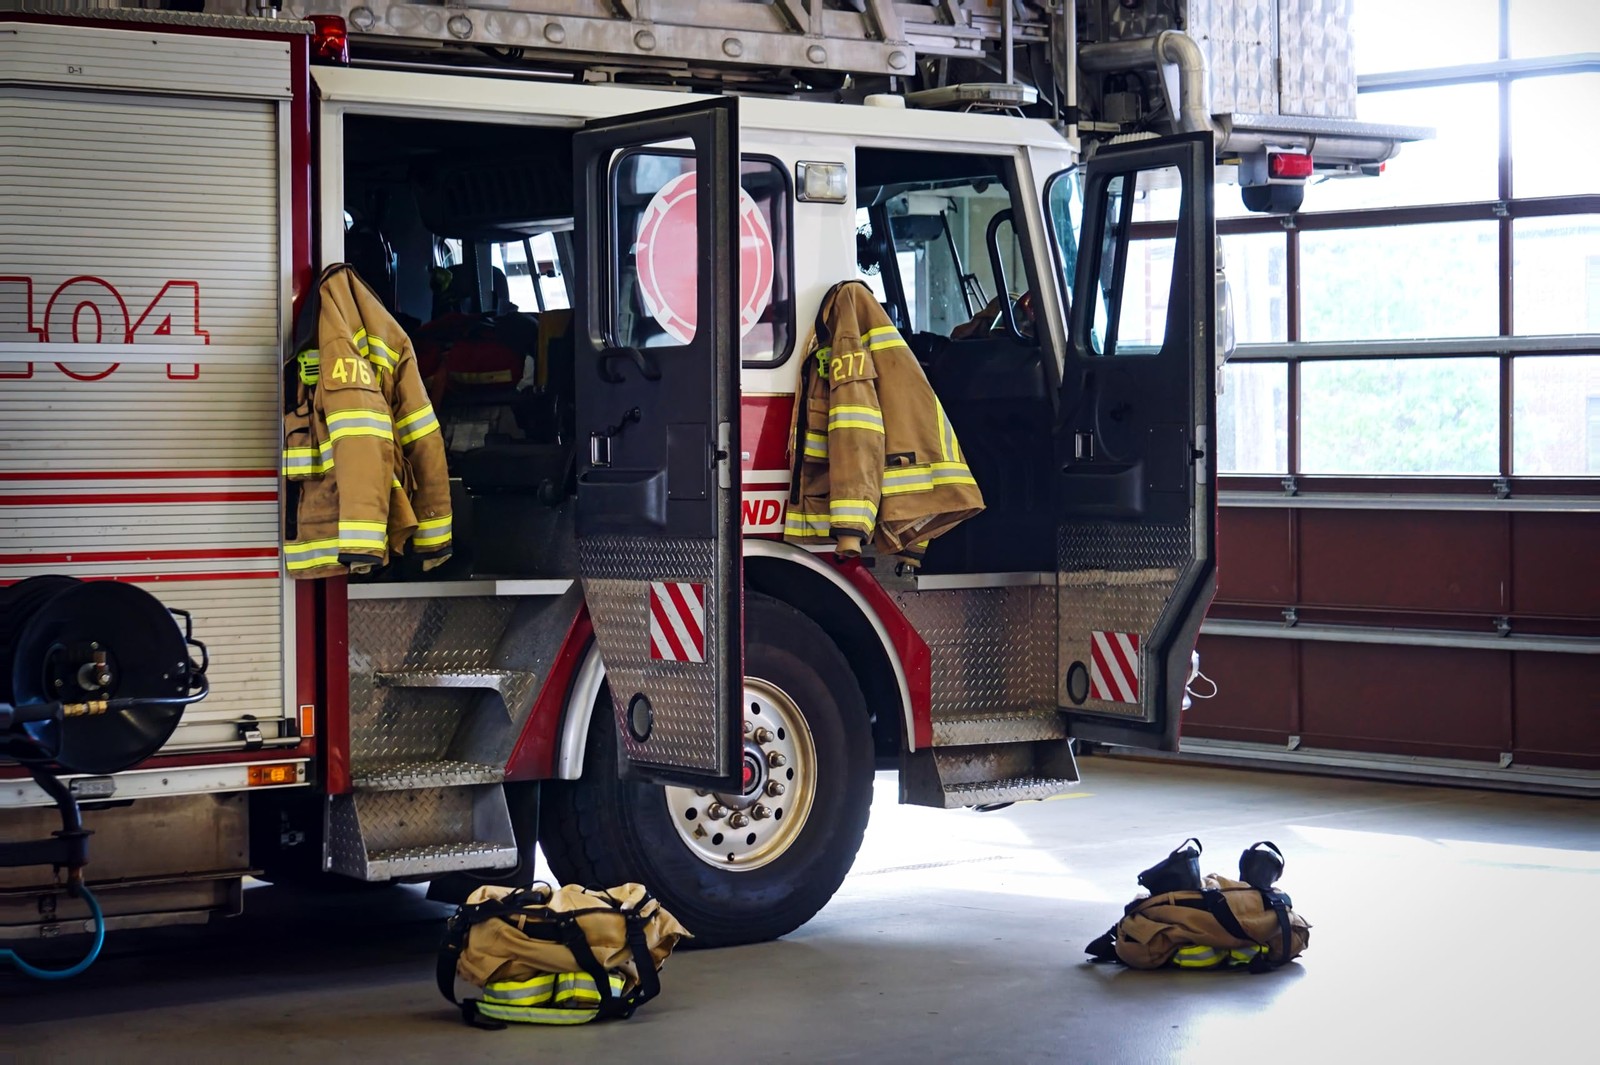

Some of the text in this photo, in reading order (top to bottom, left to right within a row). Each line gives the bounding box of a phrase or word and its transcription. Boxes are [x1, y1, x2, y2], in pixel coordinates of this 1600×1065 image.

[68, 66, 82, 74] D-1
[332, 358, 371, 385] 476
[831, 351, 866, 381] 277
